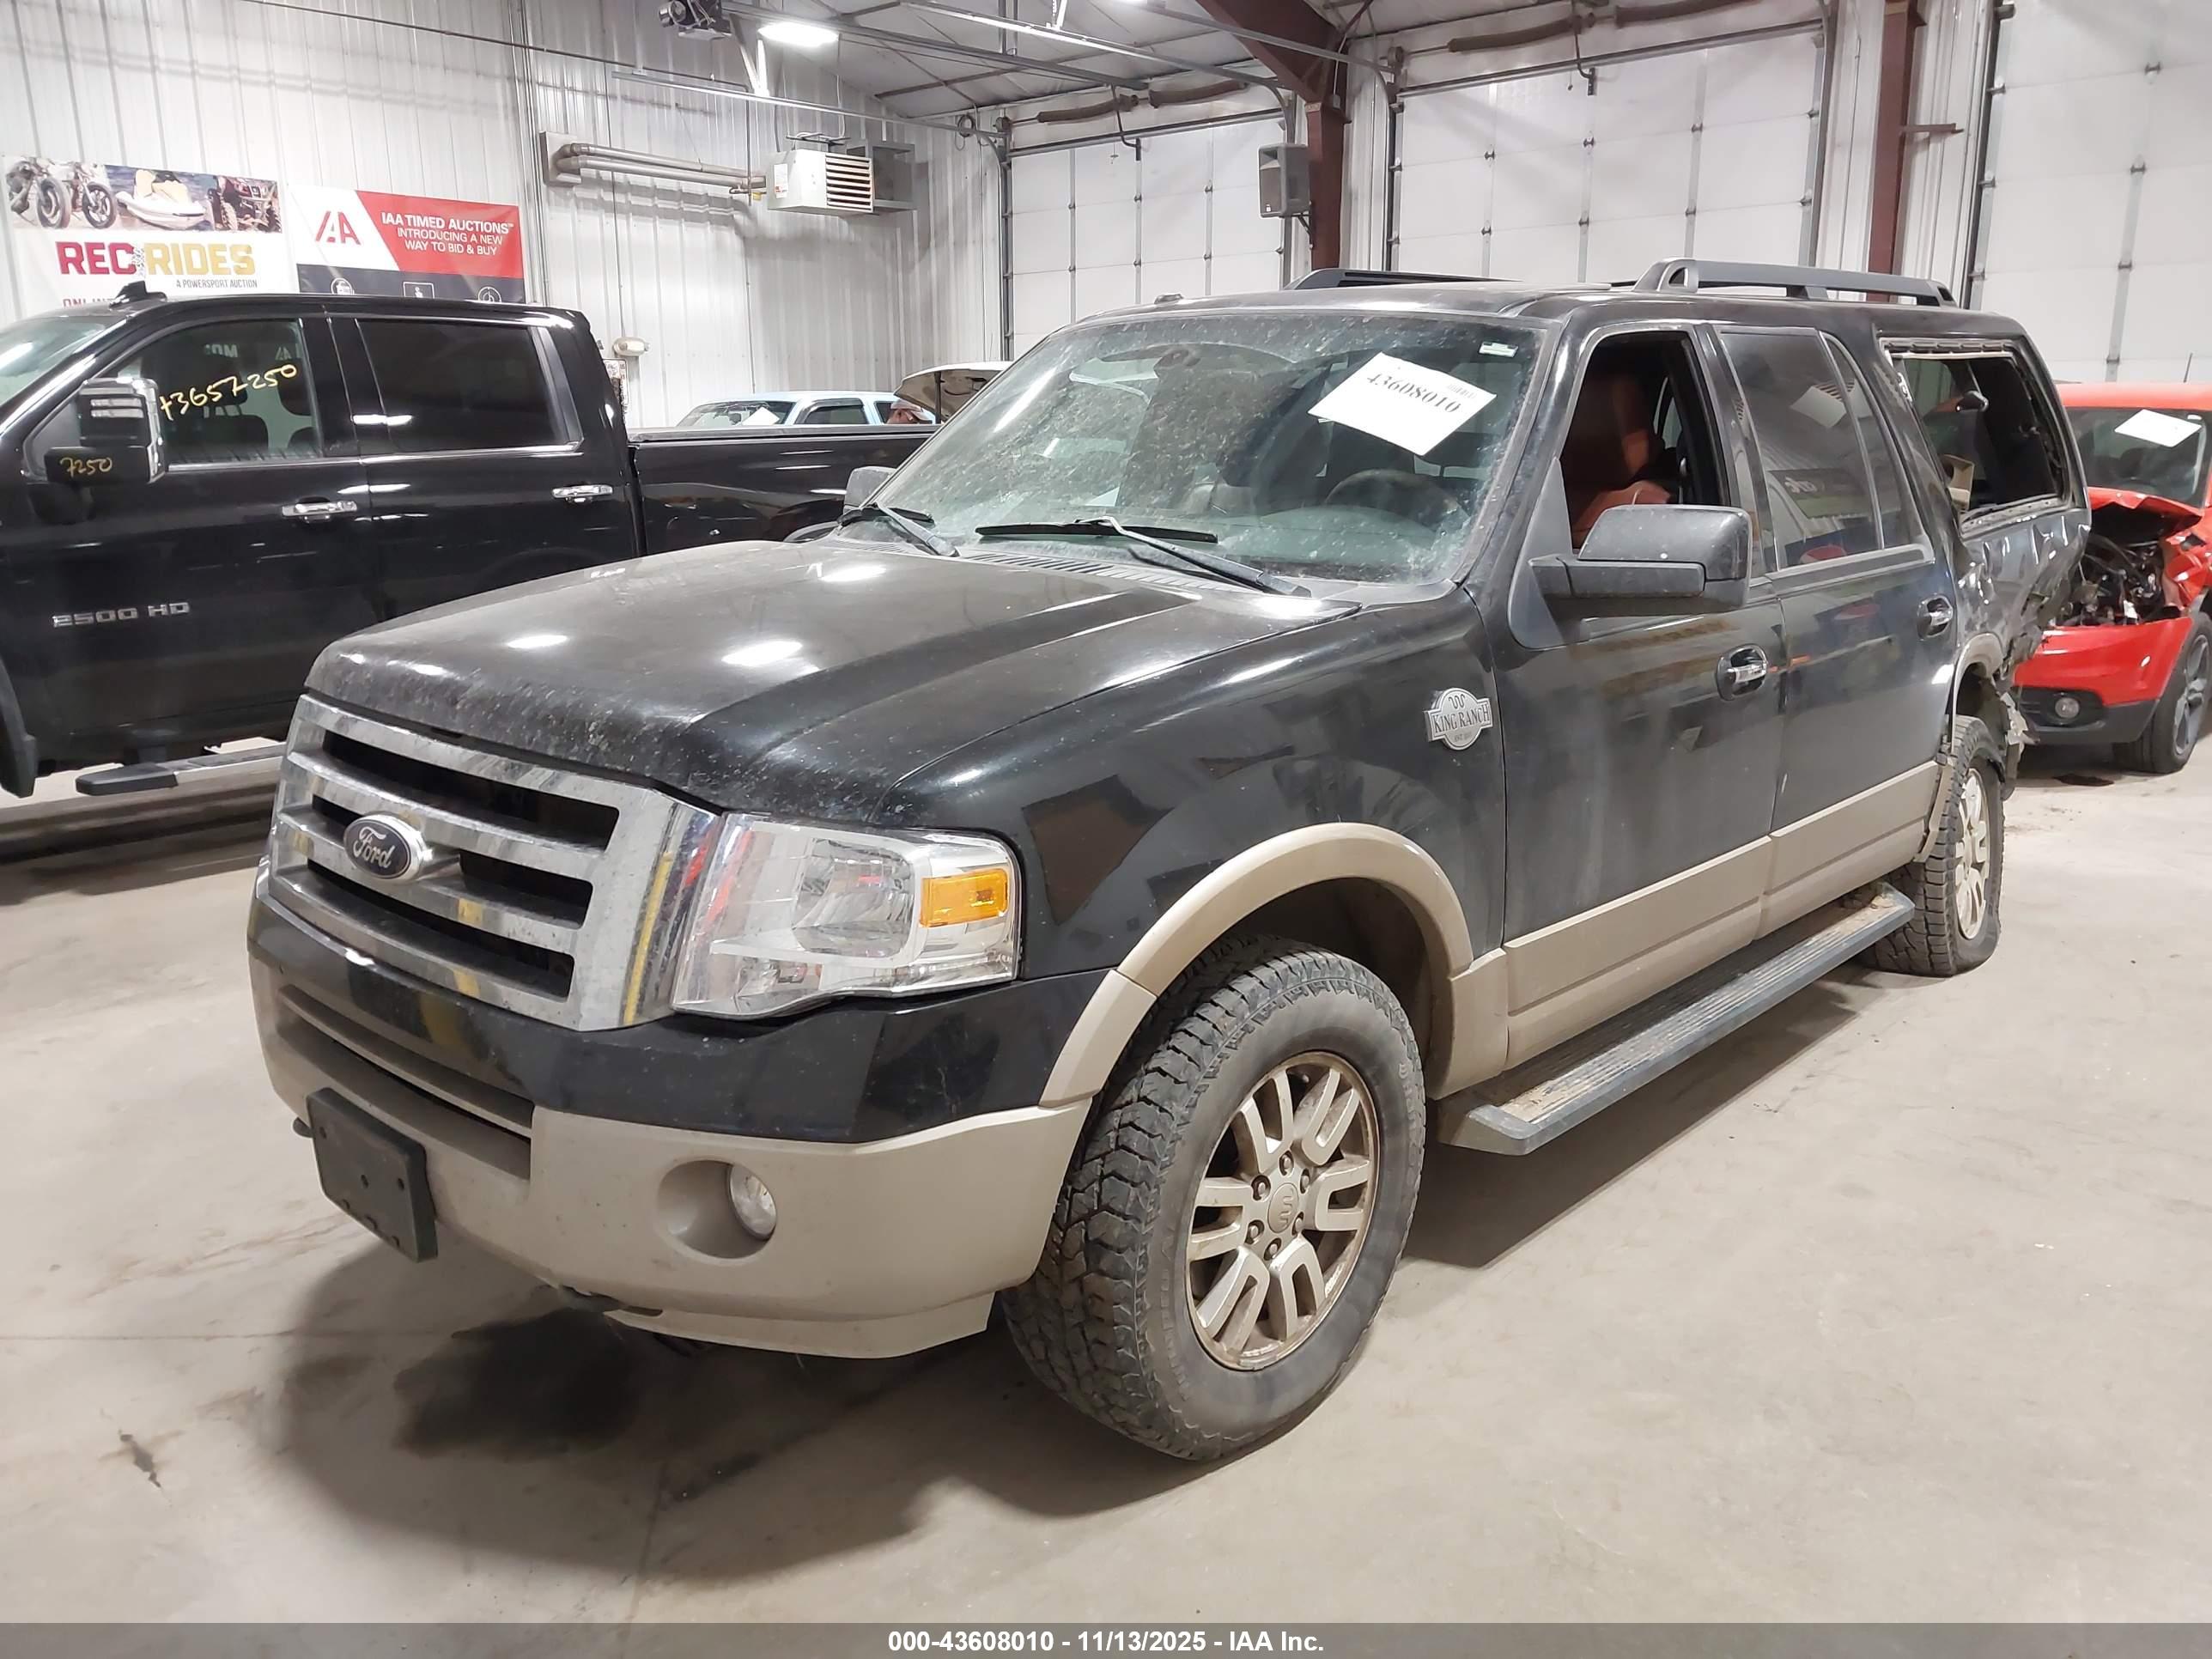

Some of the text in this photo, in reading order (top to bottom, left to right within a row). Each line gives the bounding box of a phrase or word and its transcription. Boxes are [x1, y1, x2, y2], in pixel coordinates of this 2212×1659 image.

[381, 212, 404, 225] IAA
[404, 214, 446, 229] TIMED
[398, 228, 502, 246] INTRODUCING A NEW
[404, 240, 497, 256] WAY TO BID & BUY
[55, 241, 256, 276] REC RIDES
[182, 279, 228, 289] POWERSPORT
[229, 279, 258, 289] AUCTION
[1366, 372, 1462, 413] 43608010
[59, 456, 112, 477] 7250
[148, 602, 190, 617] HD
[1432, 704, 1491, 734] KING RANCH
[353, 826, 395, 869] Ford
